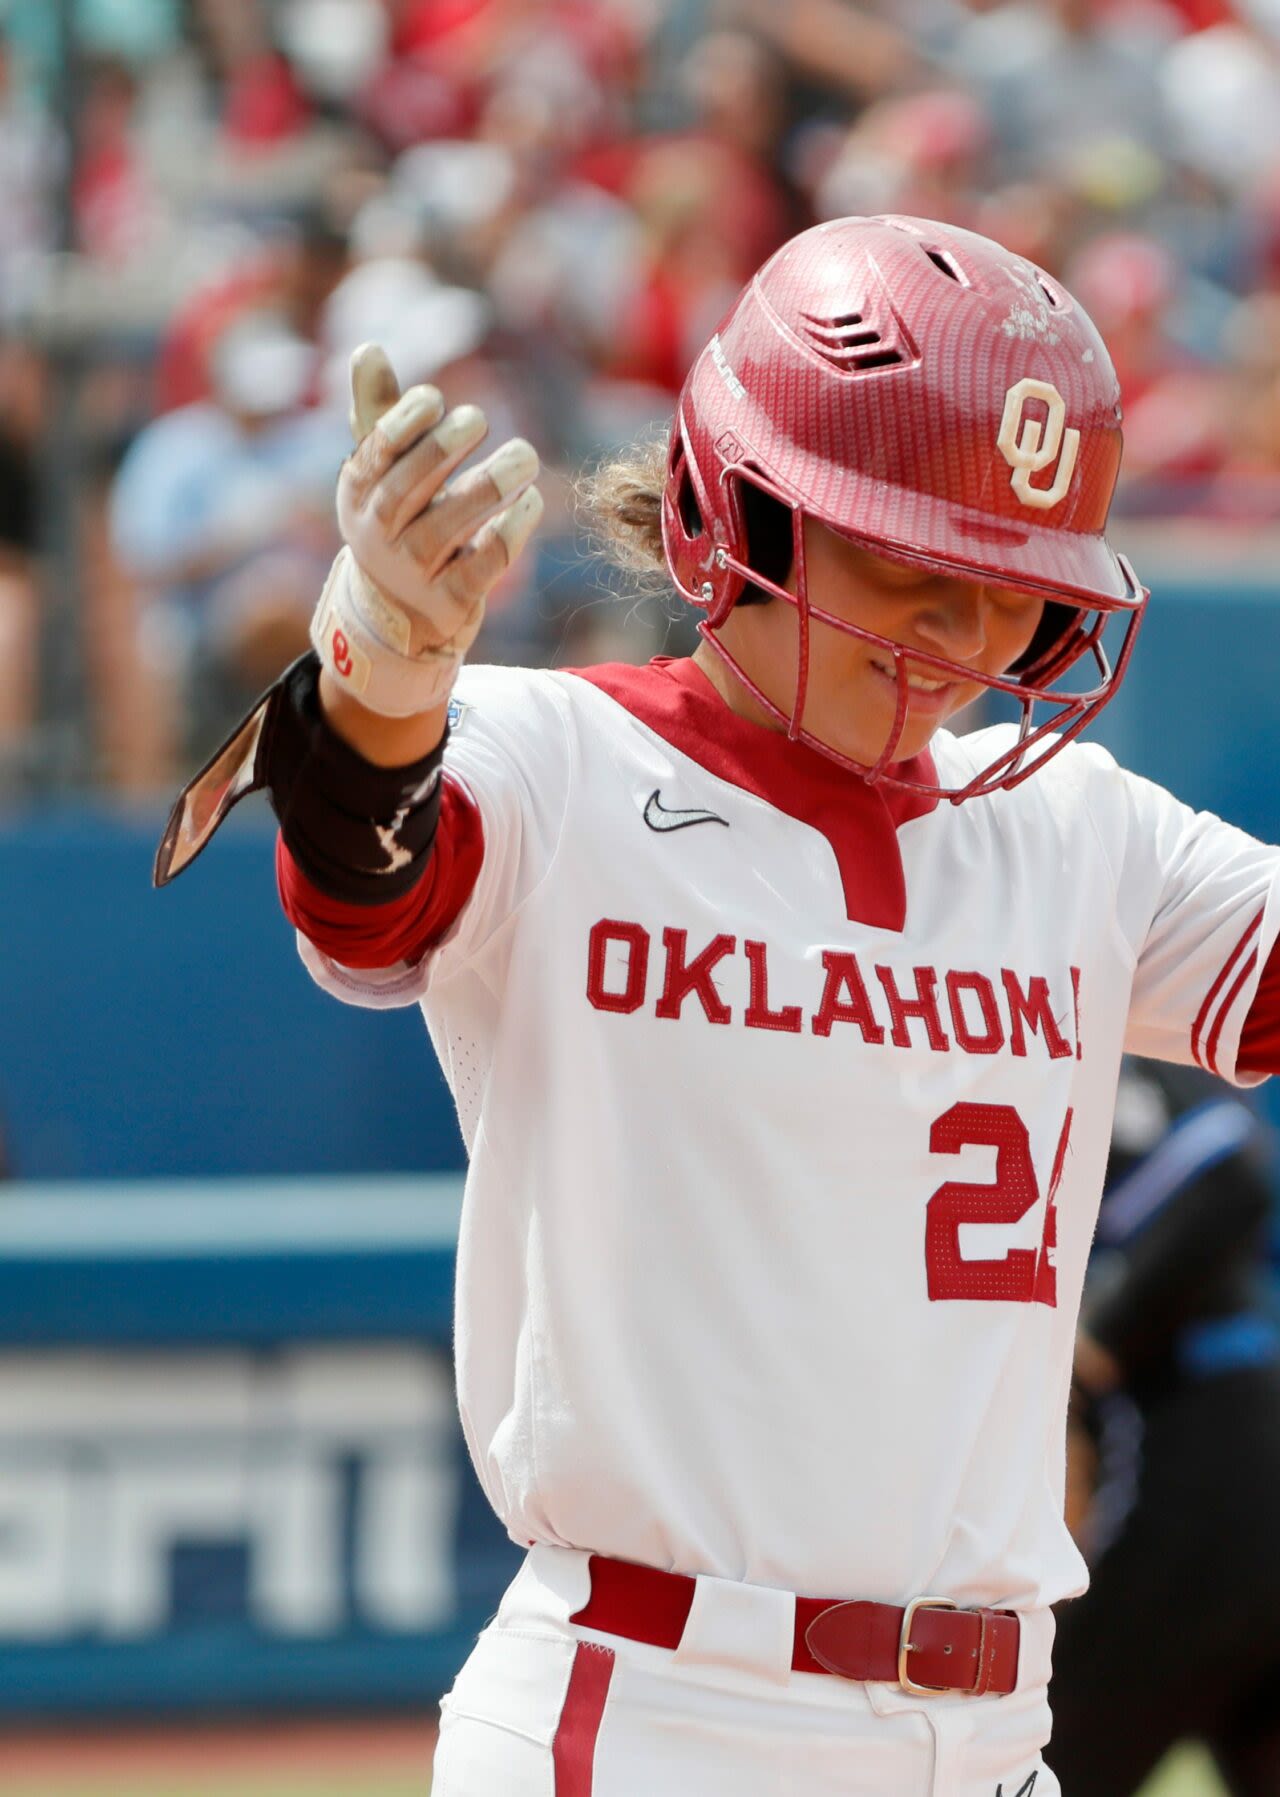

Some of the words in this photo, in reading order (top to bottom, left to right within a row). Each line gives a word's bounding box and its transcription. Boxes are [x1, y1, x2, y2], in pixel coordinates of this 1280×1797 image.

[996, 377, 1081, 511] OU
[332, 628, 353, 677] OU
[586, 918, 1082, 1061] OKLAHOM
